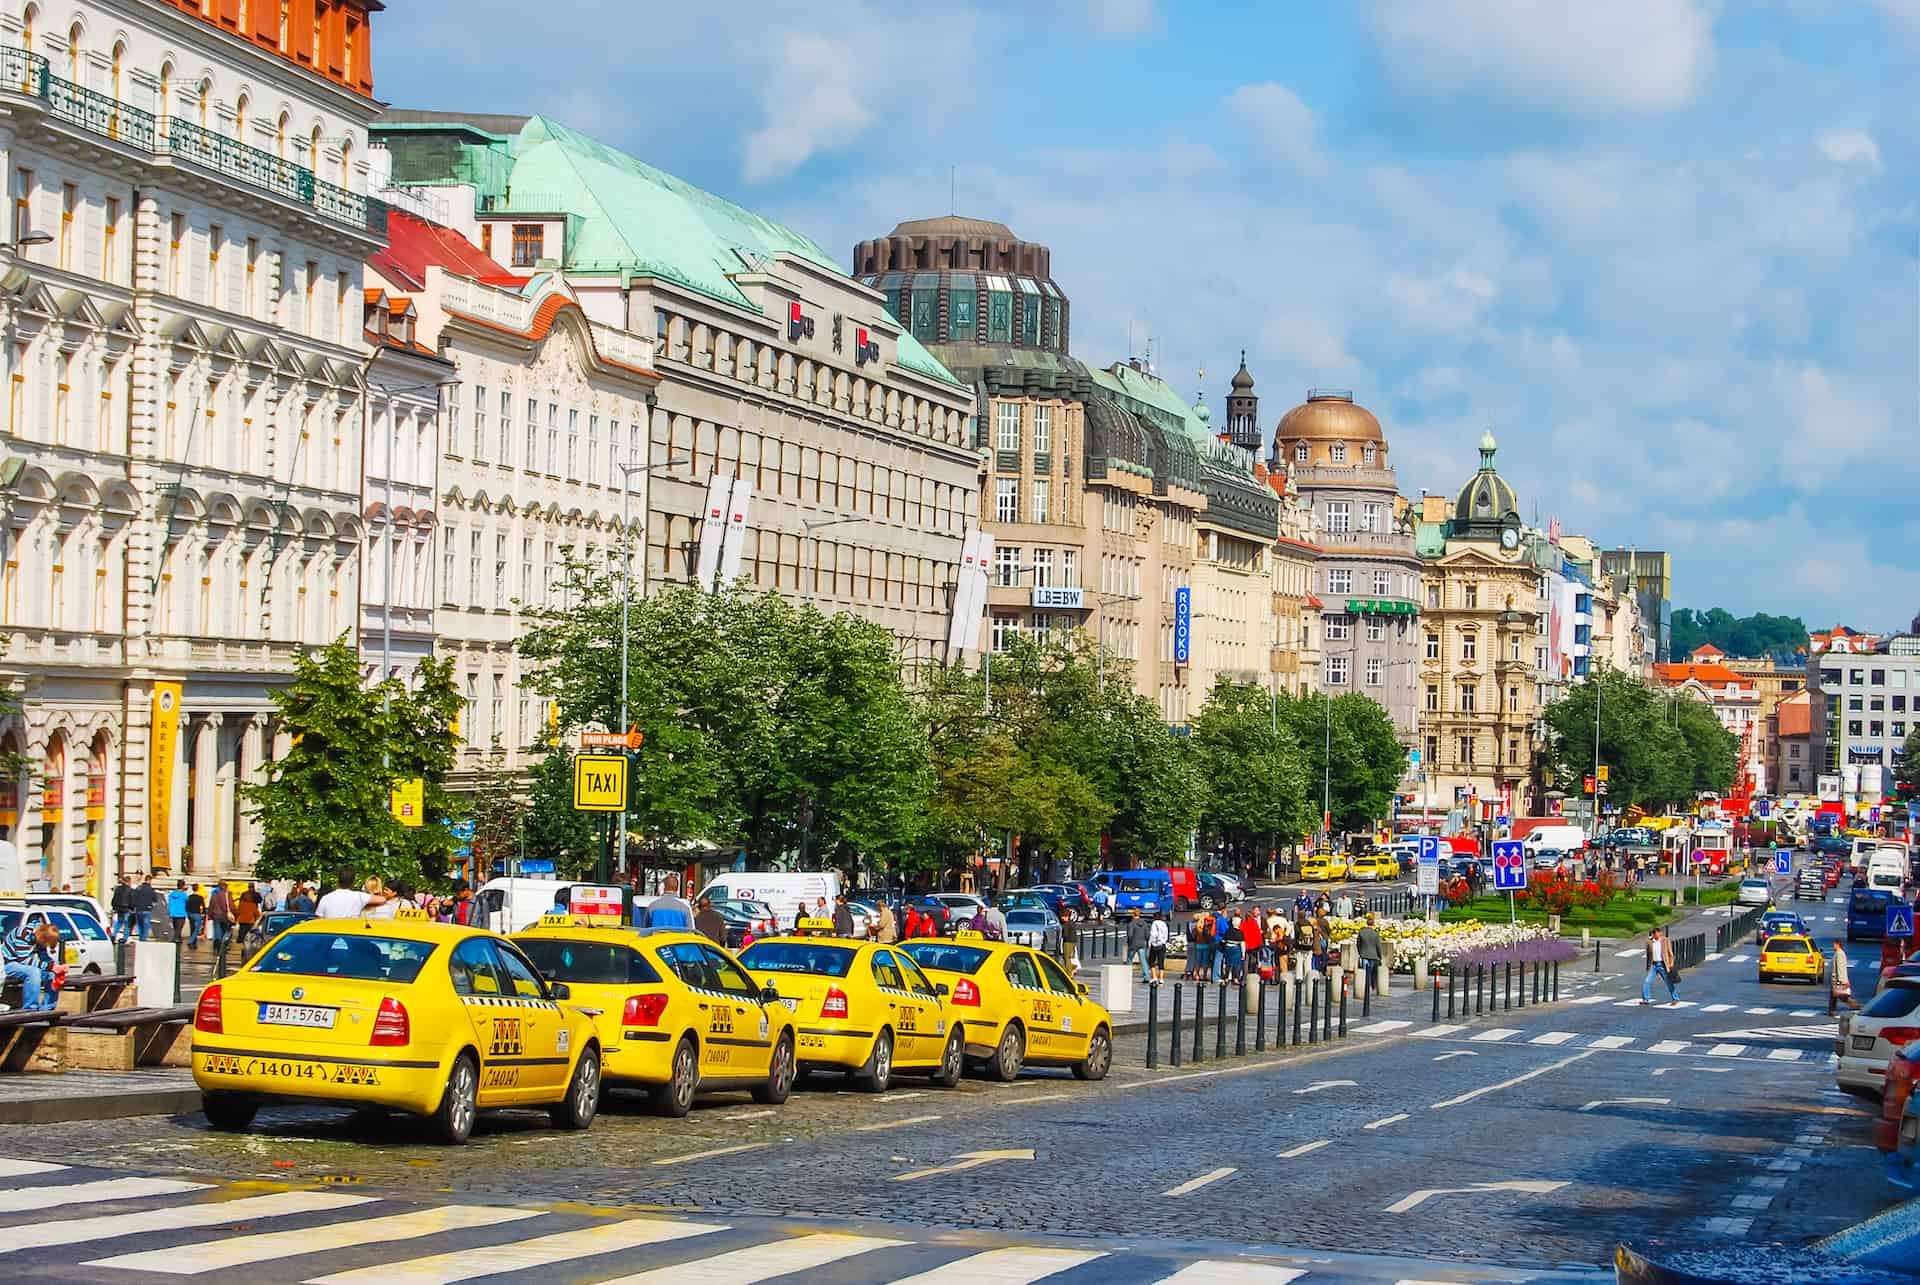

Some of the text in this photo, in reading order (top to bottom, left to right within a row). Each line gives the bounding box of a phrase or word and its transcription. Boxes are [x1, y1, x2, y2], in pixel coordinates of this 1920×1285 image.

[1177, 591, 1188, 660] ROKOKO
[583, 734, 626, 746] FAIR PLACE
[585, 773, 617, 793] TAXI
[1422, 839, 1435, 857] P
[399, 910, 422, 919] TAXI
[543, 916, 566, 925] TAXI
[268, 1006, 329, 1023] 9A1 5764
[709, 1005, 734, 1034] AAA
[489, 1018, 523, 1056] AAA
[203, 1055, 244, 1075] AAA
[330, 1065, 381, 1086] AAA
